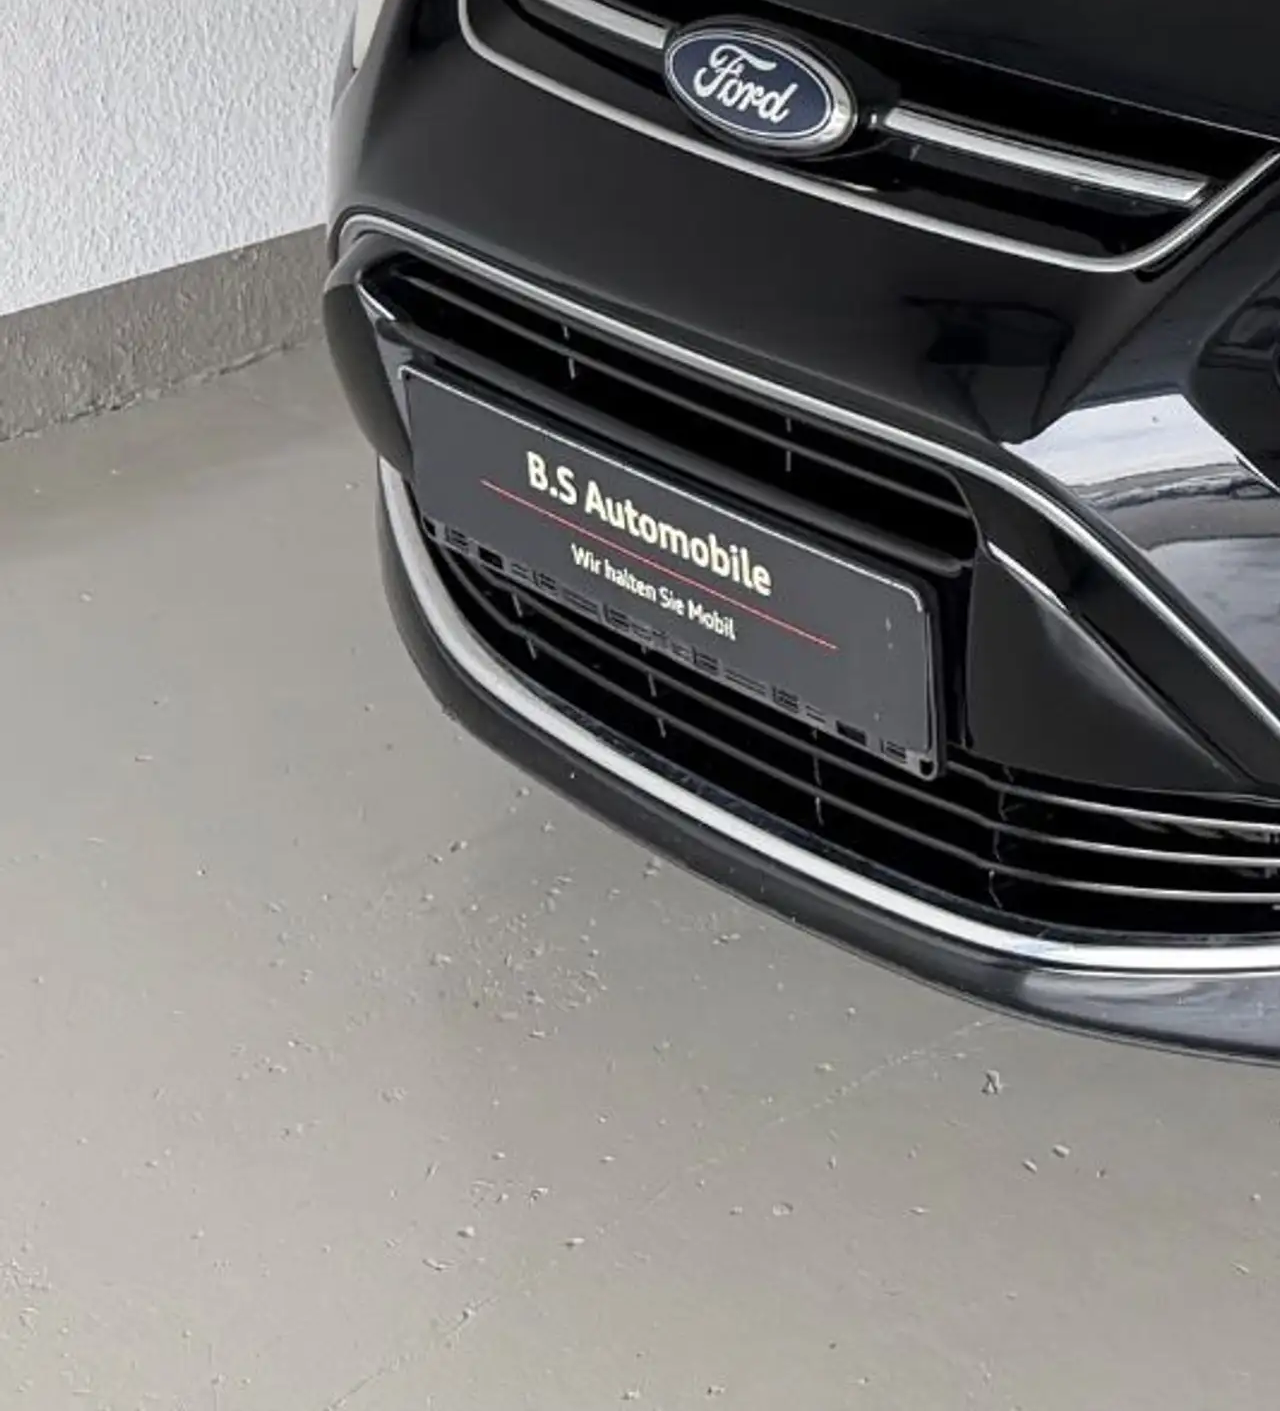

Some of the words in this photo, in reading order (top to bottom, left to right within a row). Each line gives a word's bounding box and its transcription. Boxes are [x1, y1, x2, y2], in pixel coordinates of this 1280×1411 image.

[693, 43, 798, 123] Ford
[527, 451, 577, 506] B.S
[584, 480, 772, 597] Automobile
[571, 543, 601, 575] Wir
[604, 559, 657, 602] halten
[659, 584, 685, 617] Sie
[687, 599, 736, 640] Mobil
